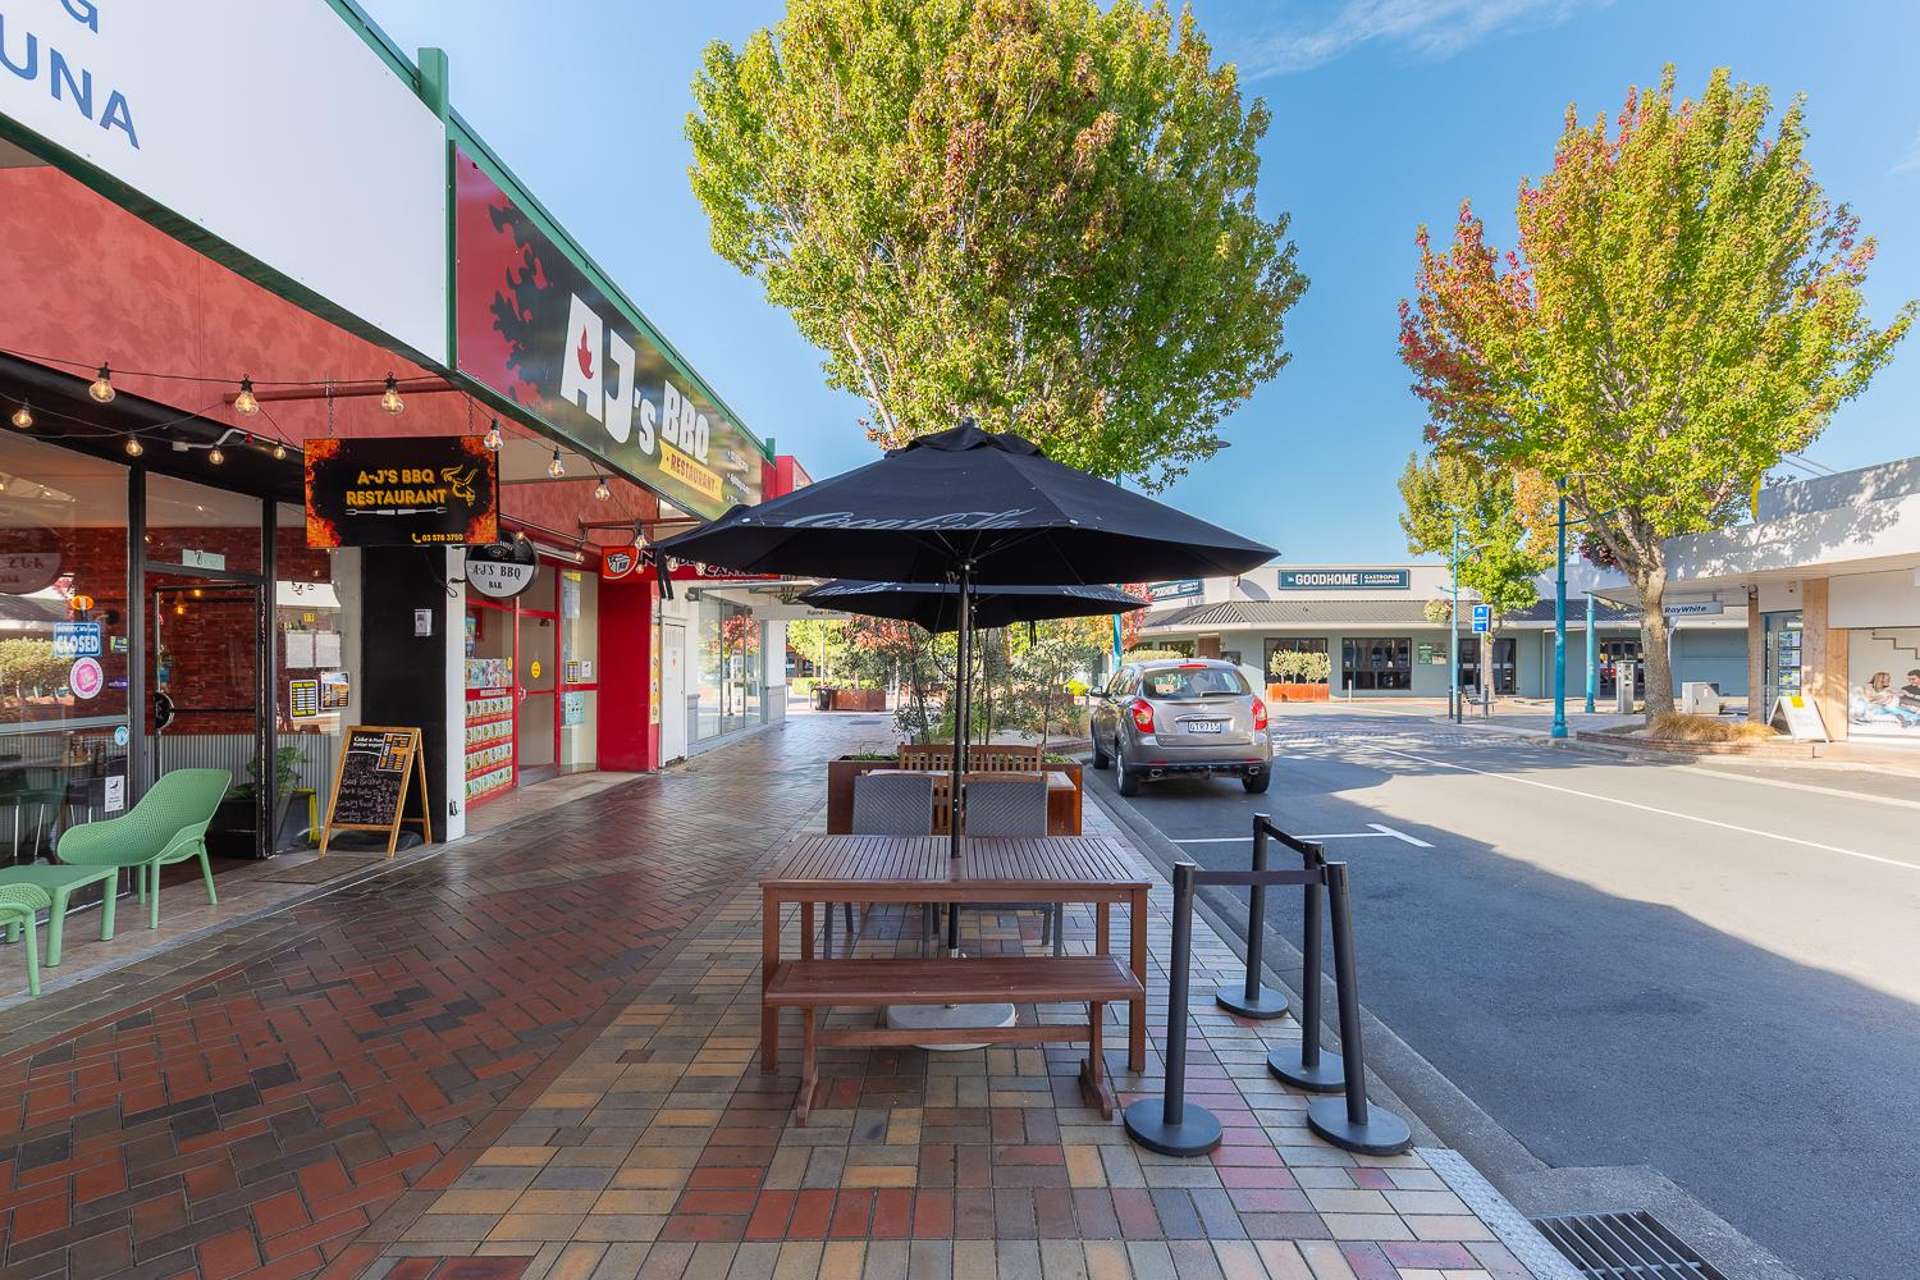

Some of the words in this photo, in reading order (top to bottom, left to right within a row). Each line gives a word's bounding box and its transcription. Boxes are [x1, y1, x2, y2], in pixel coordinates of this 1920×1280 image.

[661, 379, 710, 465] BBQ
[401, 468, 435, 485] BBQ
[671, 452, 716, 493] RESTAURANT
[346, 488, 447, 506] RESTAURANT
[500, 566, 521, 581] BBQ
[1295, 573, 1358, 585] GOODHOME
[56, 635, 98, 653] CLOSED
